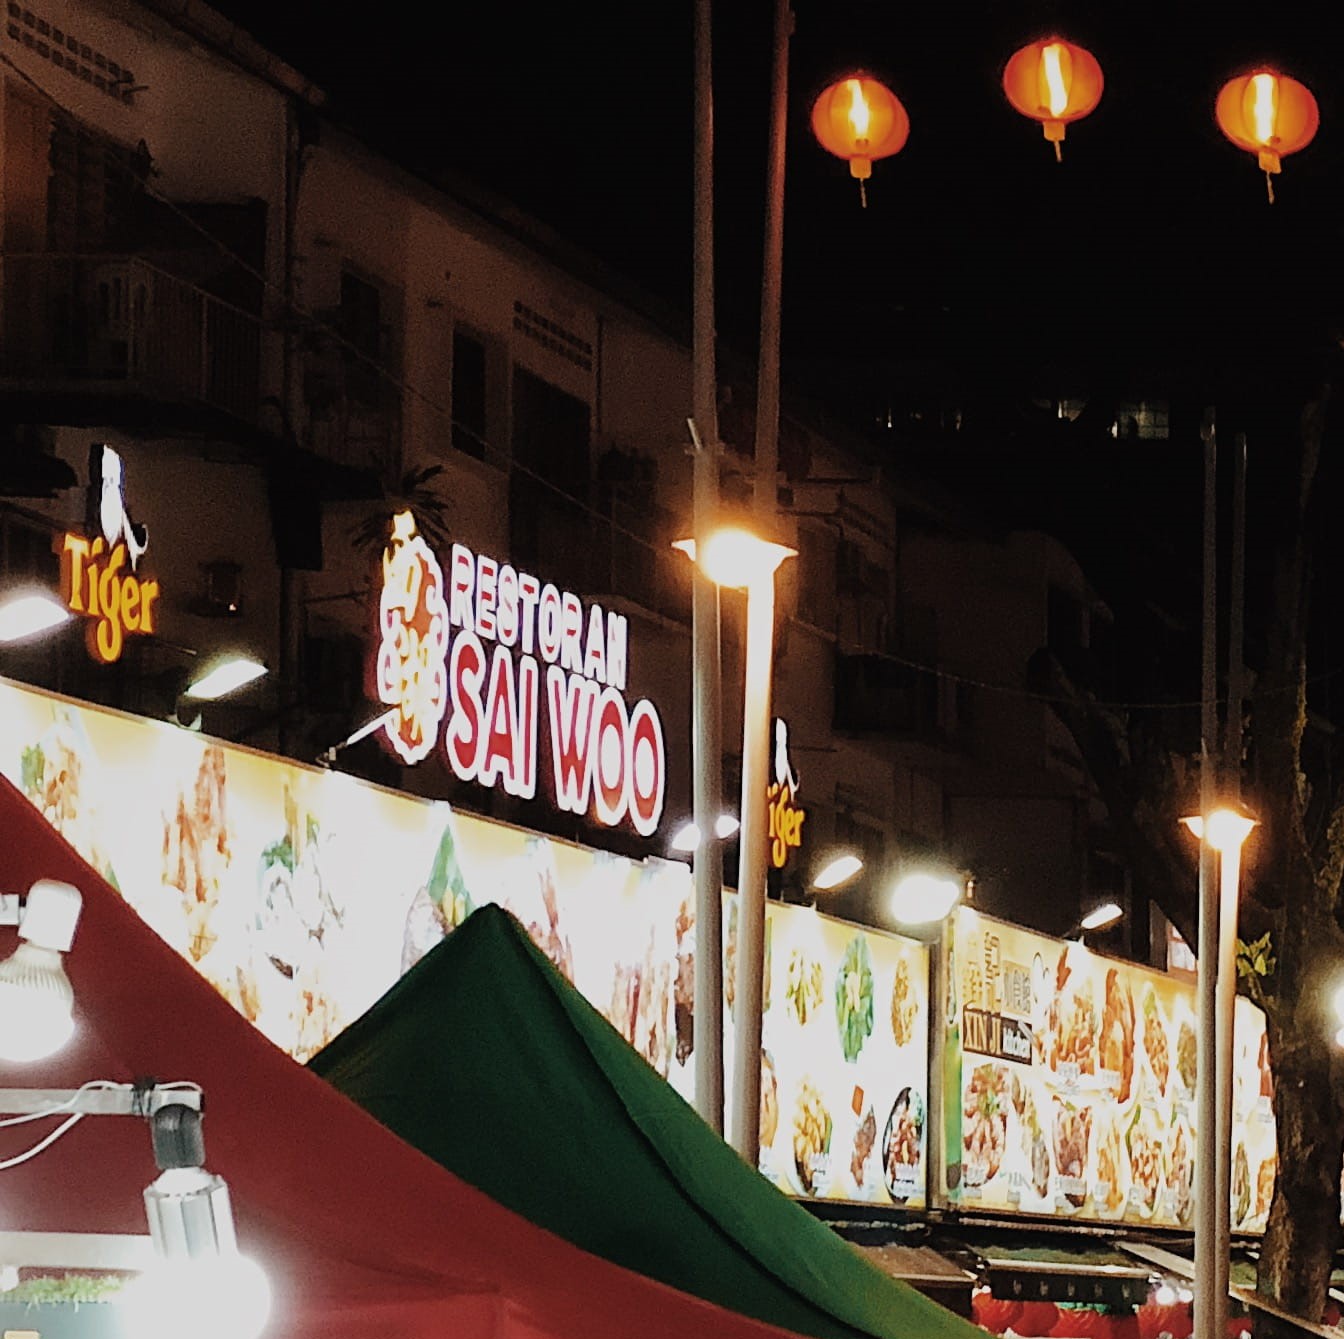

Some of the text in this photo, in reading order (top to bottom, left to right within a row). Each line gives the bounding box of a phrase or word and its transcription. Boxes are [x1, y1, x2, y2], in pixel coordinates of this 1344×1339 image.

[63, 532, 159, 662] Tiger
[450, 543, 628, 691] RESTORAN
[446, 629, 666, 836] SAI WOO
[767, 782, 805, 868] iger
